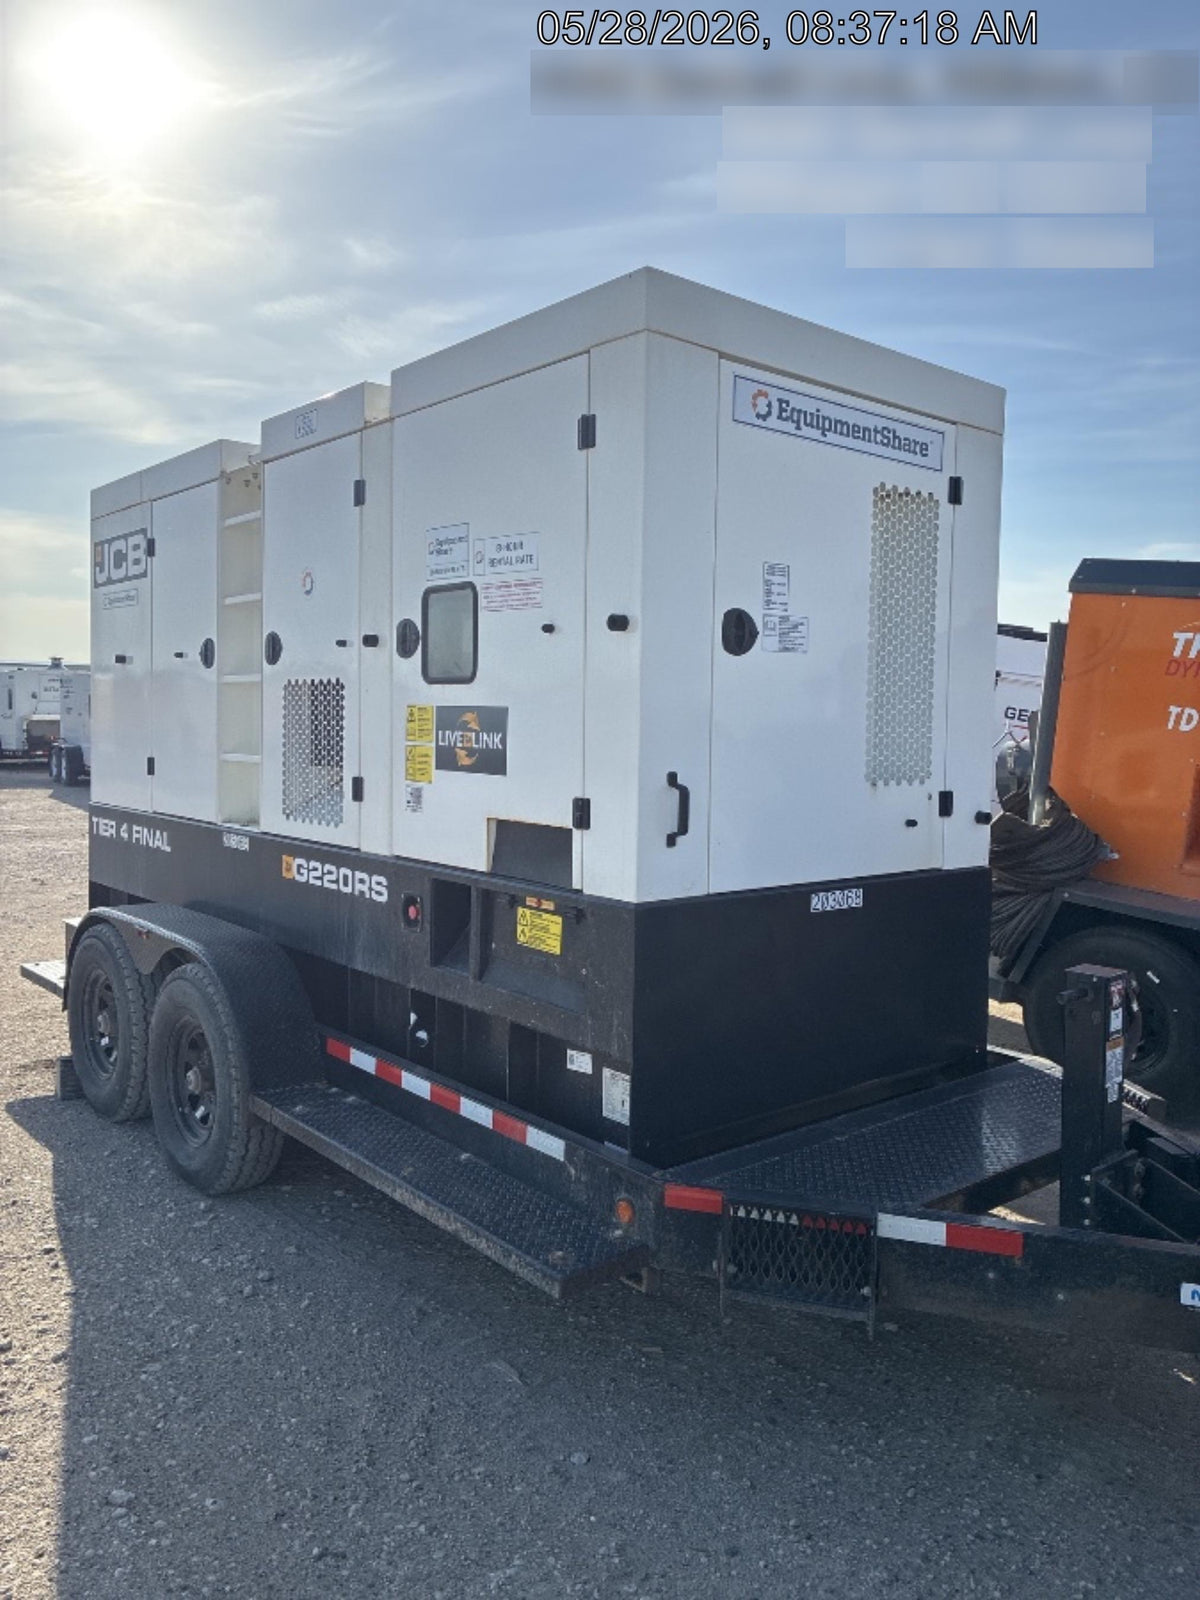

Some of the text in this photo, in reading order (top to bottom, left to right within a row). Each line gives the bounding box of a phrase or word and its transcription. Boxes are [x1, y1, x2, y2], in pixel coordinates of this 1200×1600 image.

[776, 397, 929, 457] EquipmentShare
[95, 532, 147, 583] JCB
[1004, 706, 1034, 722] GE
[438, 730, 503, 750] LIVE LINK
[91, 815, 172, 853] TIER 4 FINAL
[294, 857, 389, 903] G220RS
